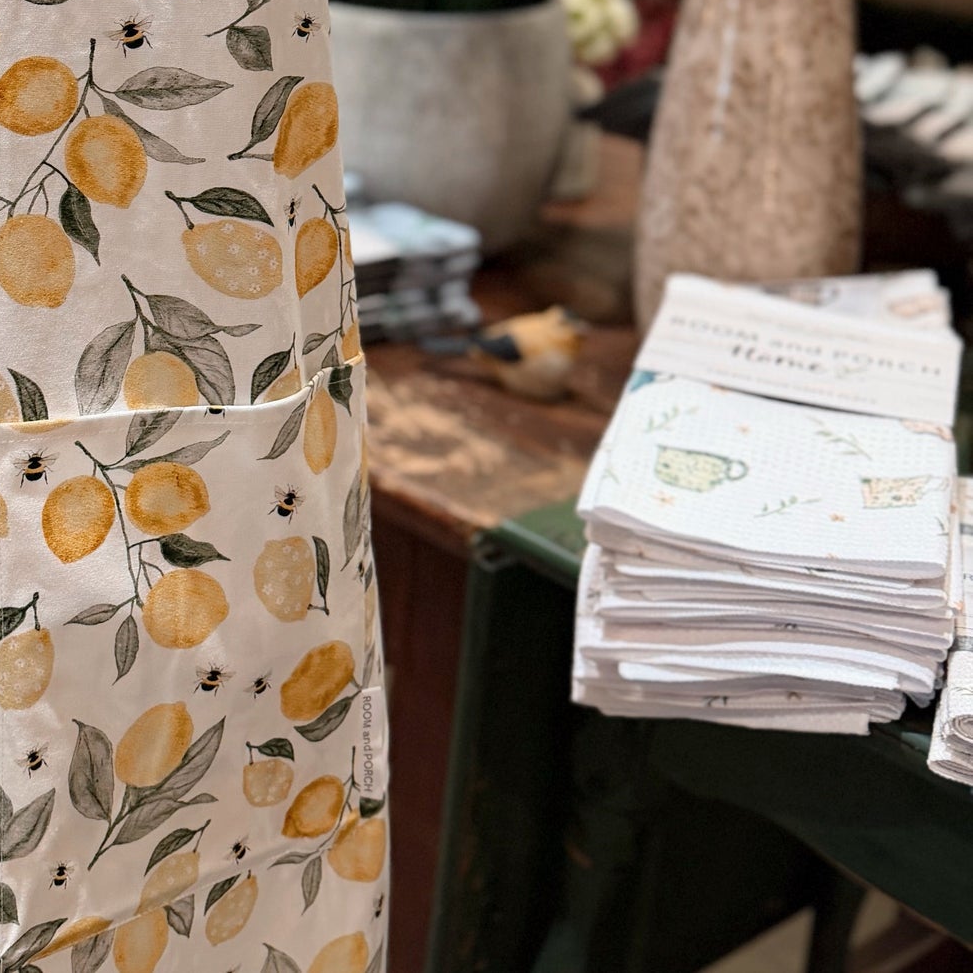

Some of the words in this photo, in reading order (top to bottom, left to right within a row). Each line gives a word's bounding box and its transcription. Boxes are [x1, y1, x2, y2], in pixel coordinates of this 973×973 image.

[730, 344, 828, 374] Home
[769, 338, 822, 357] and
[362, 695, 372, 728] ROOM
[362, 731, 373, 751] and
[363, 753, 374, 793] PORCH
